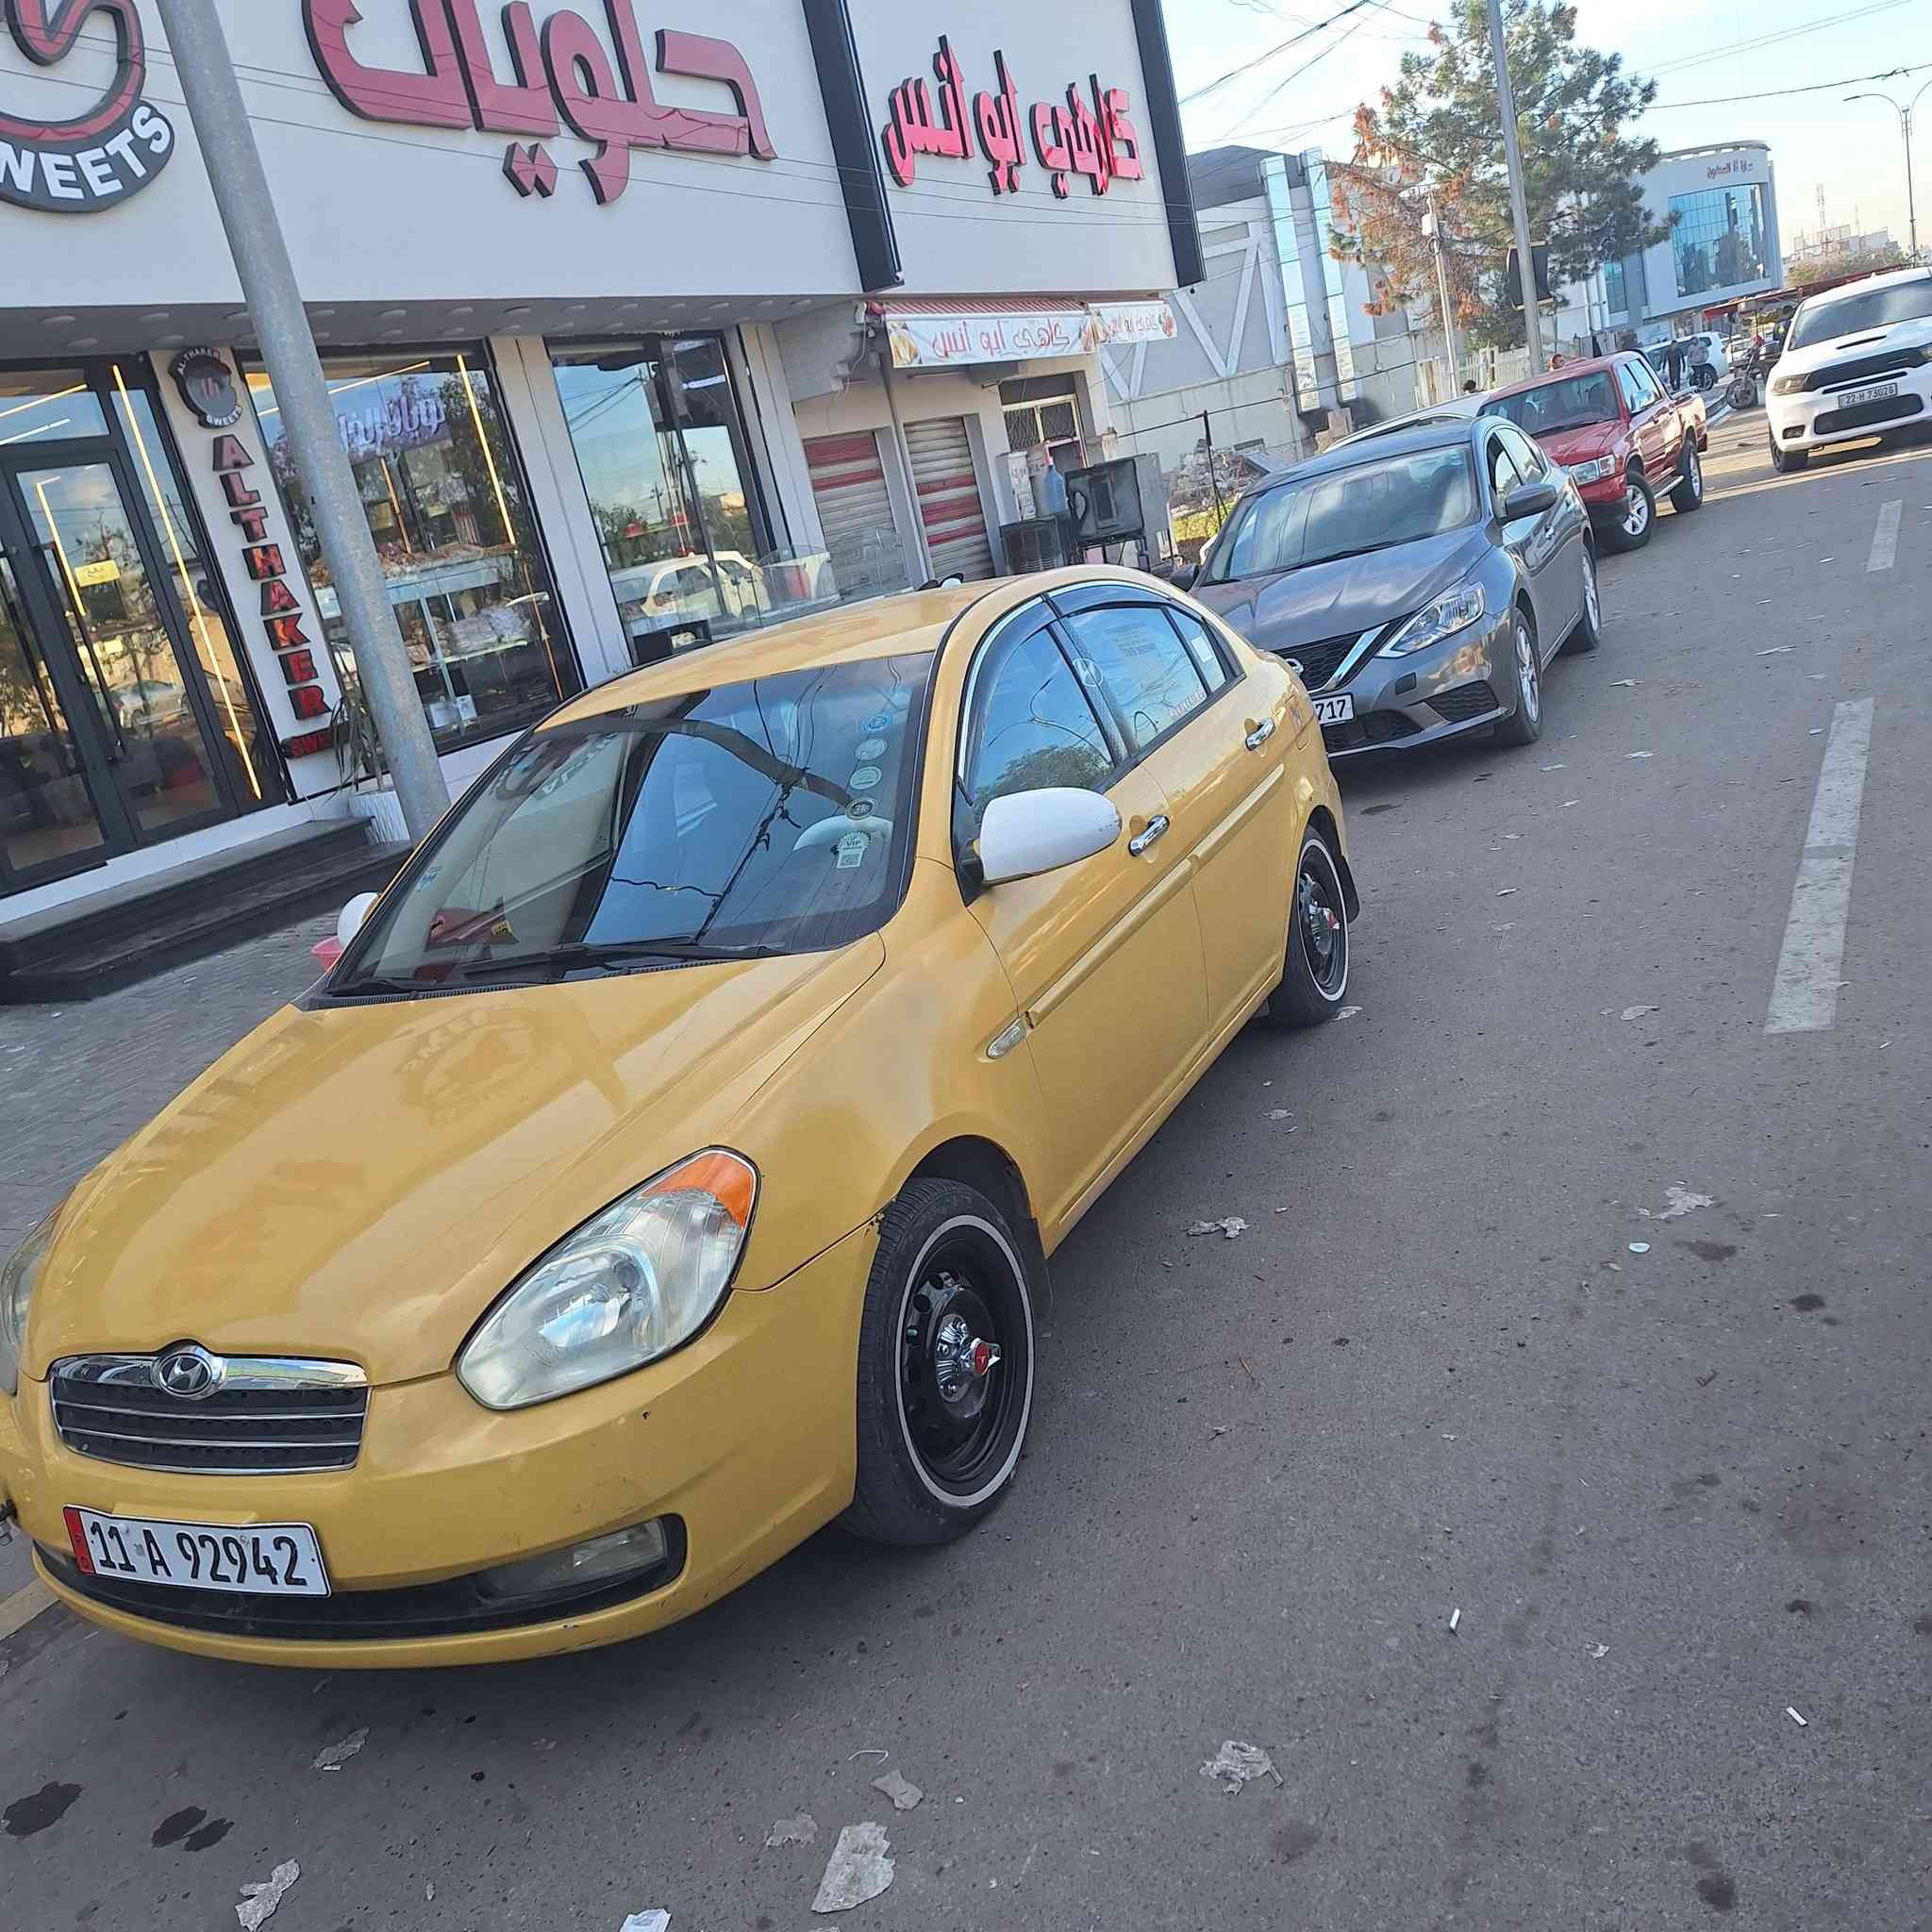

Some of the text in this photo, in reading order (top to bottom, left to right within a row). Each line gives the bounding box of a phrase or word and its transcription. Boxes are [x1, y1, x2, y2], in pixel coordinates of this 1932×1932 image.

[212, 433, 332, 721] ALTHAKER
[91, 1521, 137, 1573] 11
[142, 1529, 172, 1577] A
[175, 1532, 308, 1586] 92942
